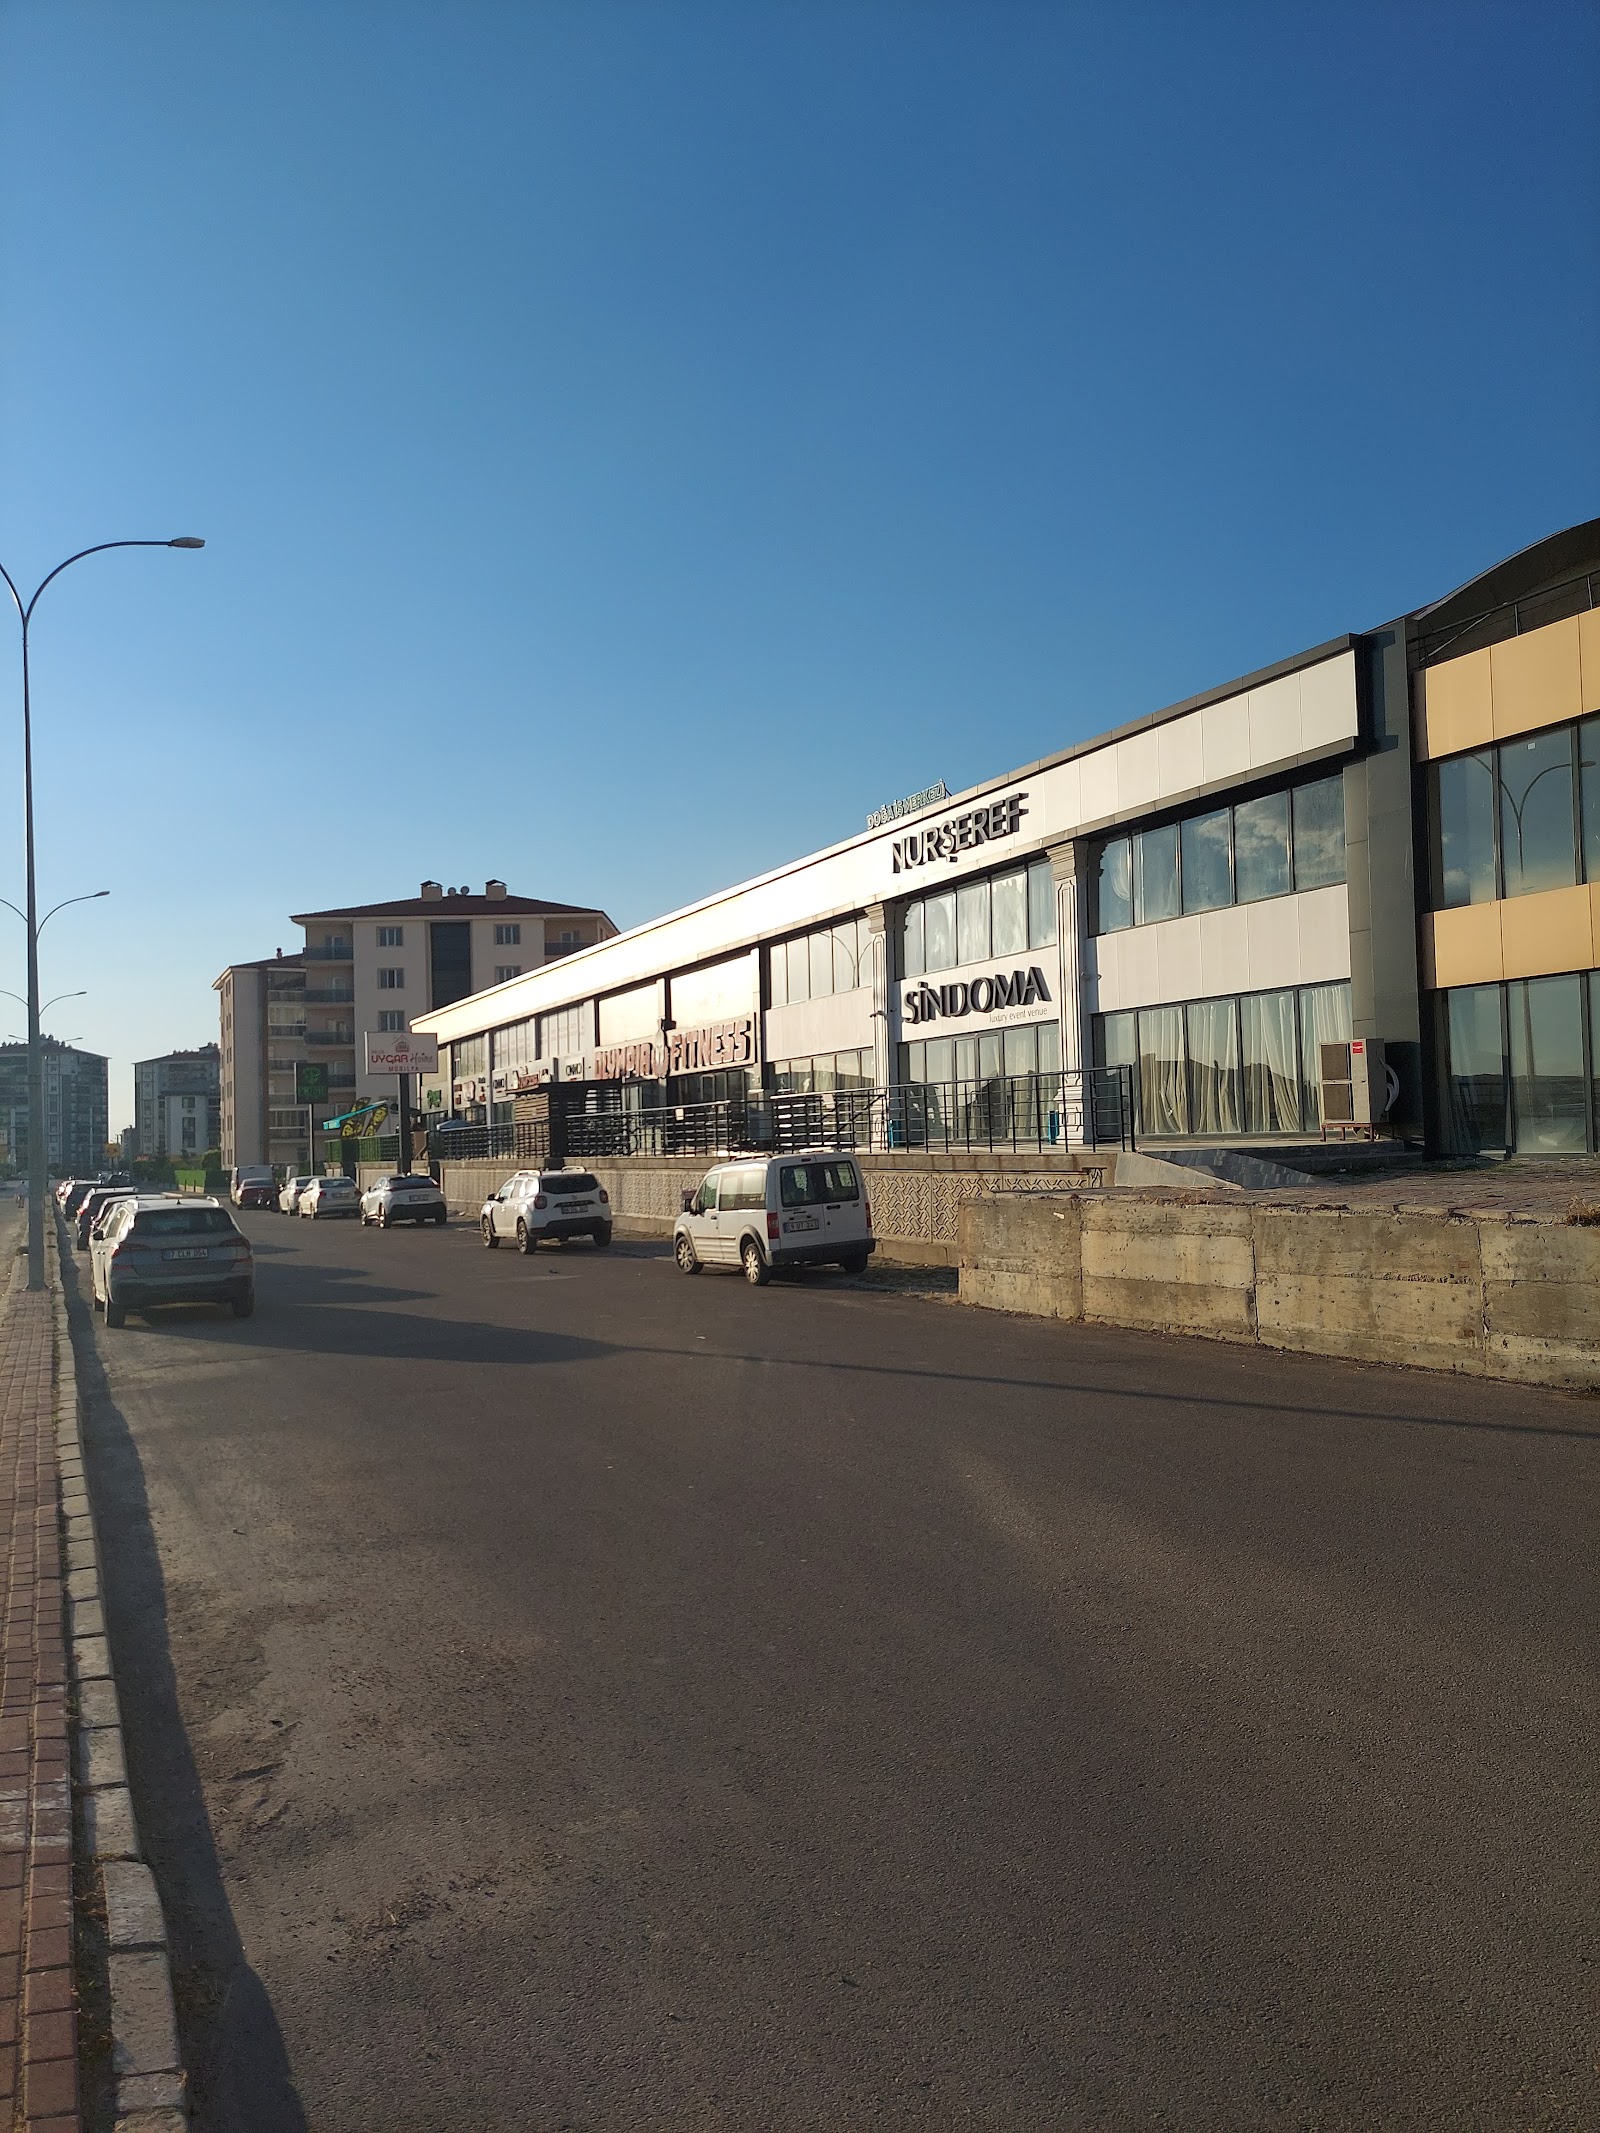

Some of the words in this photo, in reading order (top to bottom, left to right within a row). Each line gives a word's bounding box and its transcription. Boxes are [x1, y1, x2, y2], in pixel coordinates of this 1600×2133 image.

[892, 792, 1029, 874] NURŞEREF
[900, 966, 1052, 1024] SİNDOMA
[1009, 1009, 1027, 1021] event
[1028, 1007, 1048, 1018] venue
[371, 1054, 409, 1065] UYGAR
[670, 1019, 752, 1072] FITNESS
